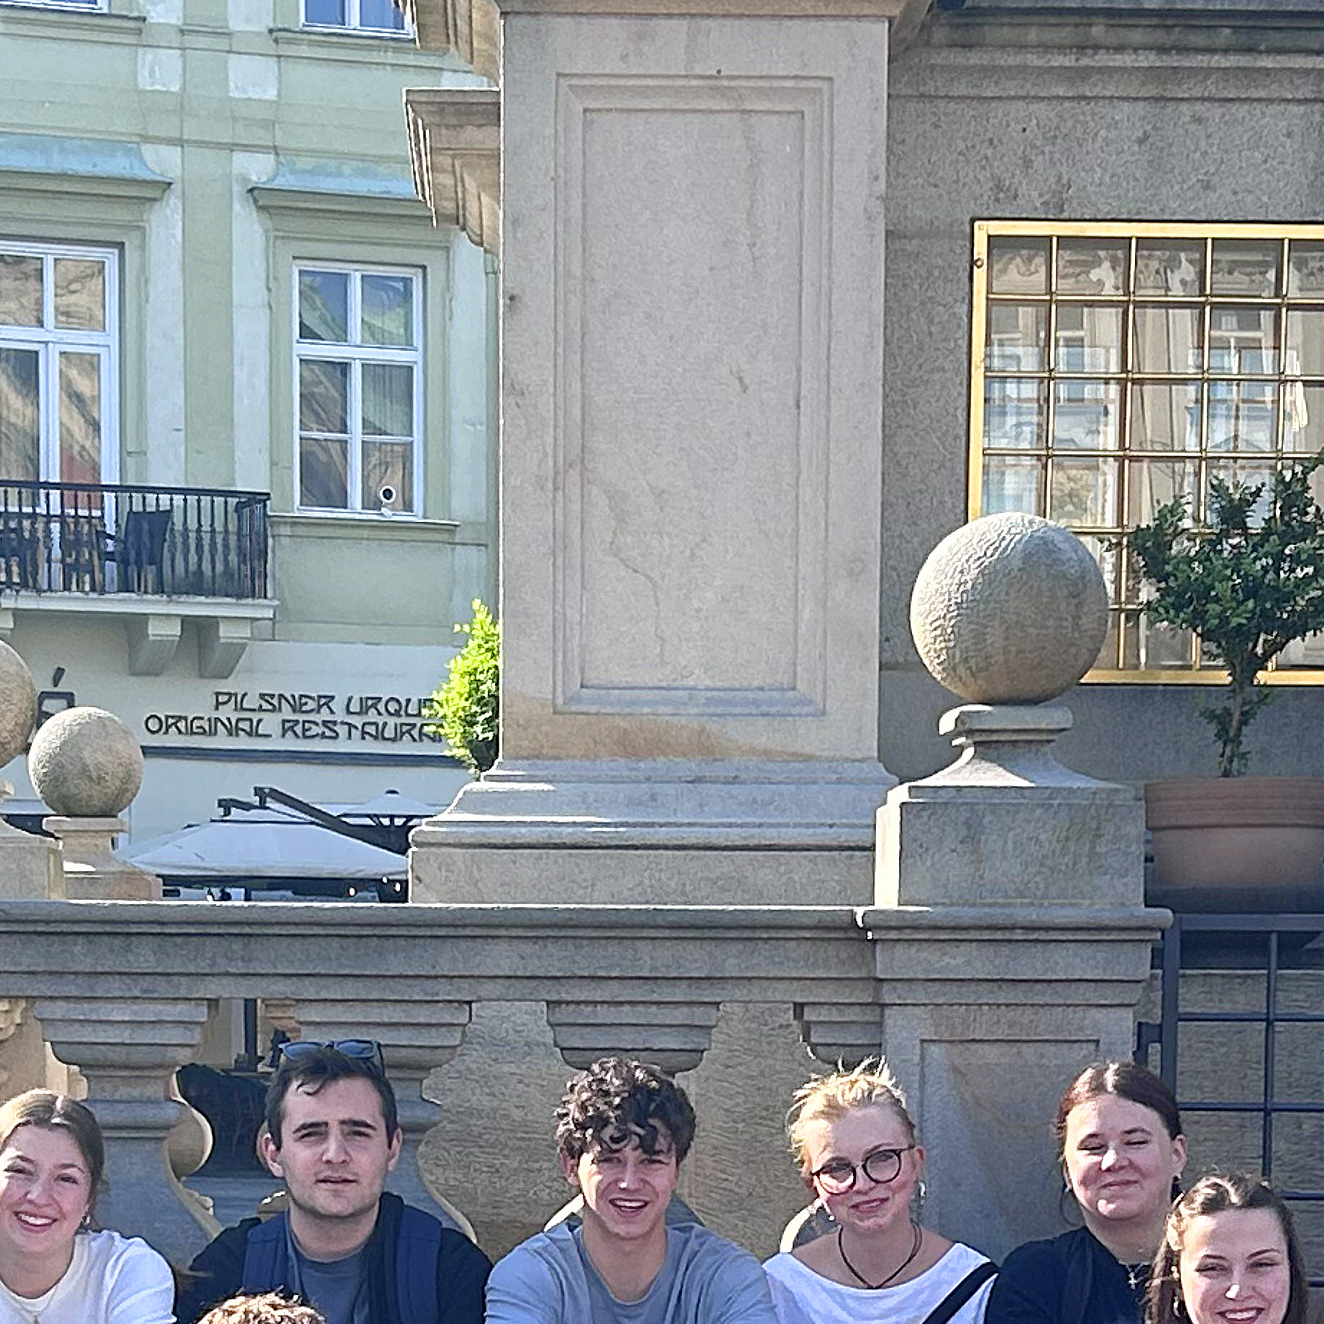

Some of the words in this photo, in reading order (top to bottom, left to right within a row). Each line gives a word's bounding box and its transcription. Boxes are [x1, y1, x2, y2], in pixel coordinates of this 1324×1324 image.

[213, 691, 336, 716] PILSNER
[346, 695, 443, 719] URQU
[144, 714, 273, 739] ORIGINAL
[281, 718, 444, 743] RESTAURA
